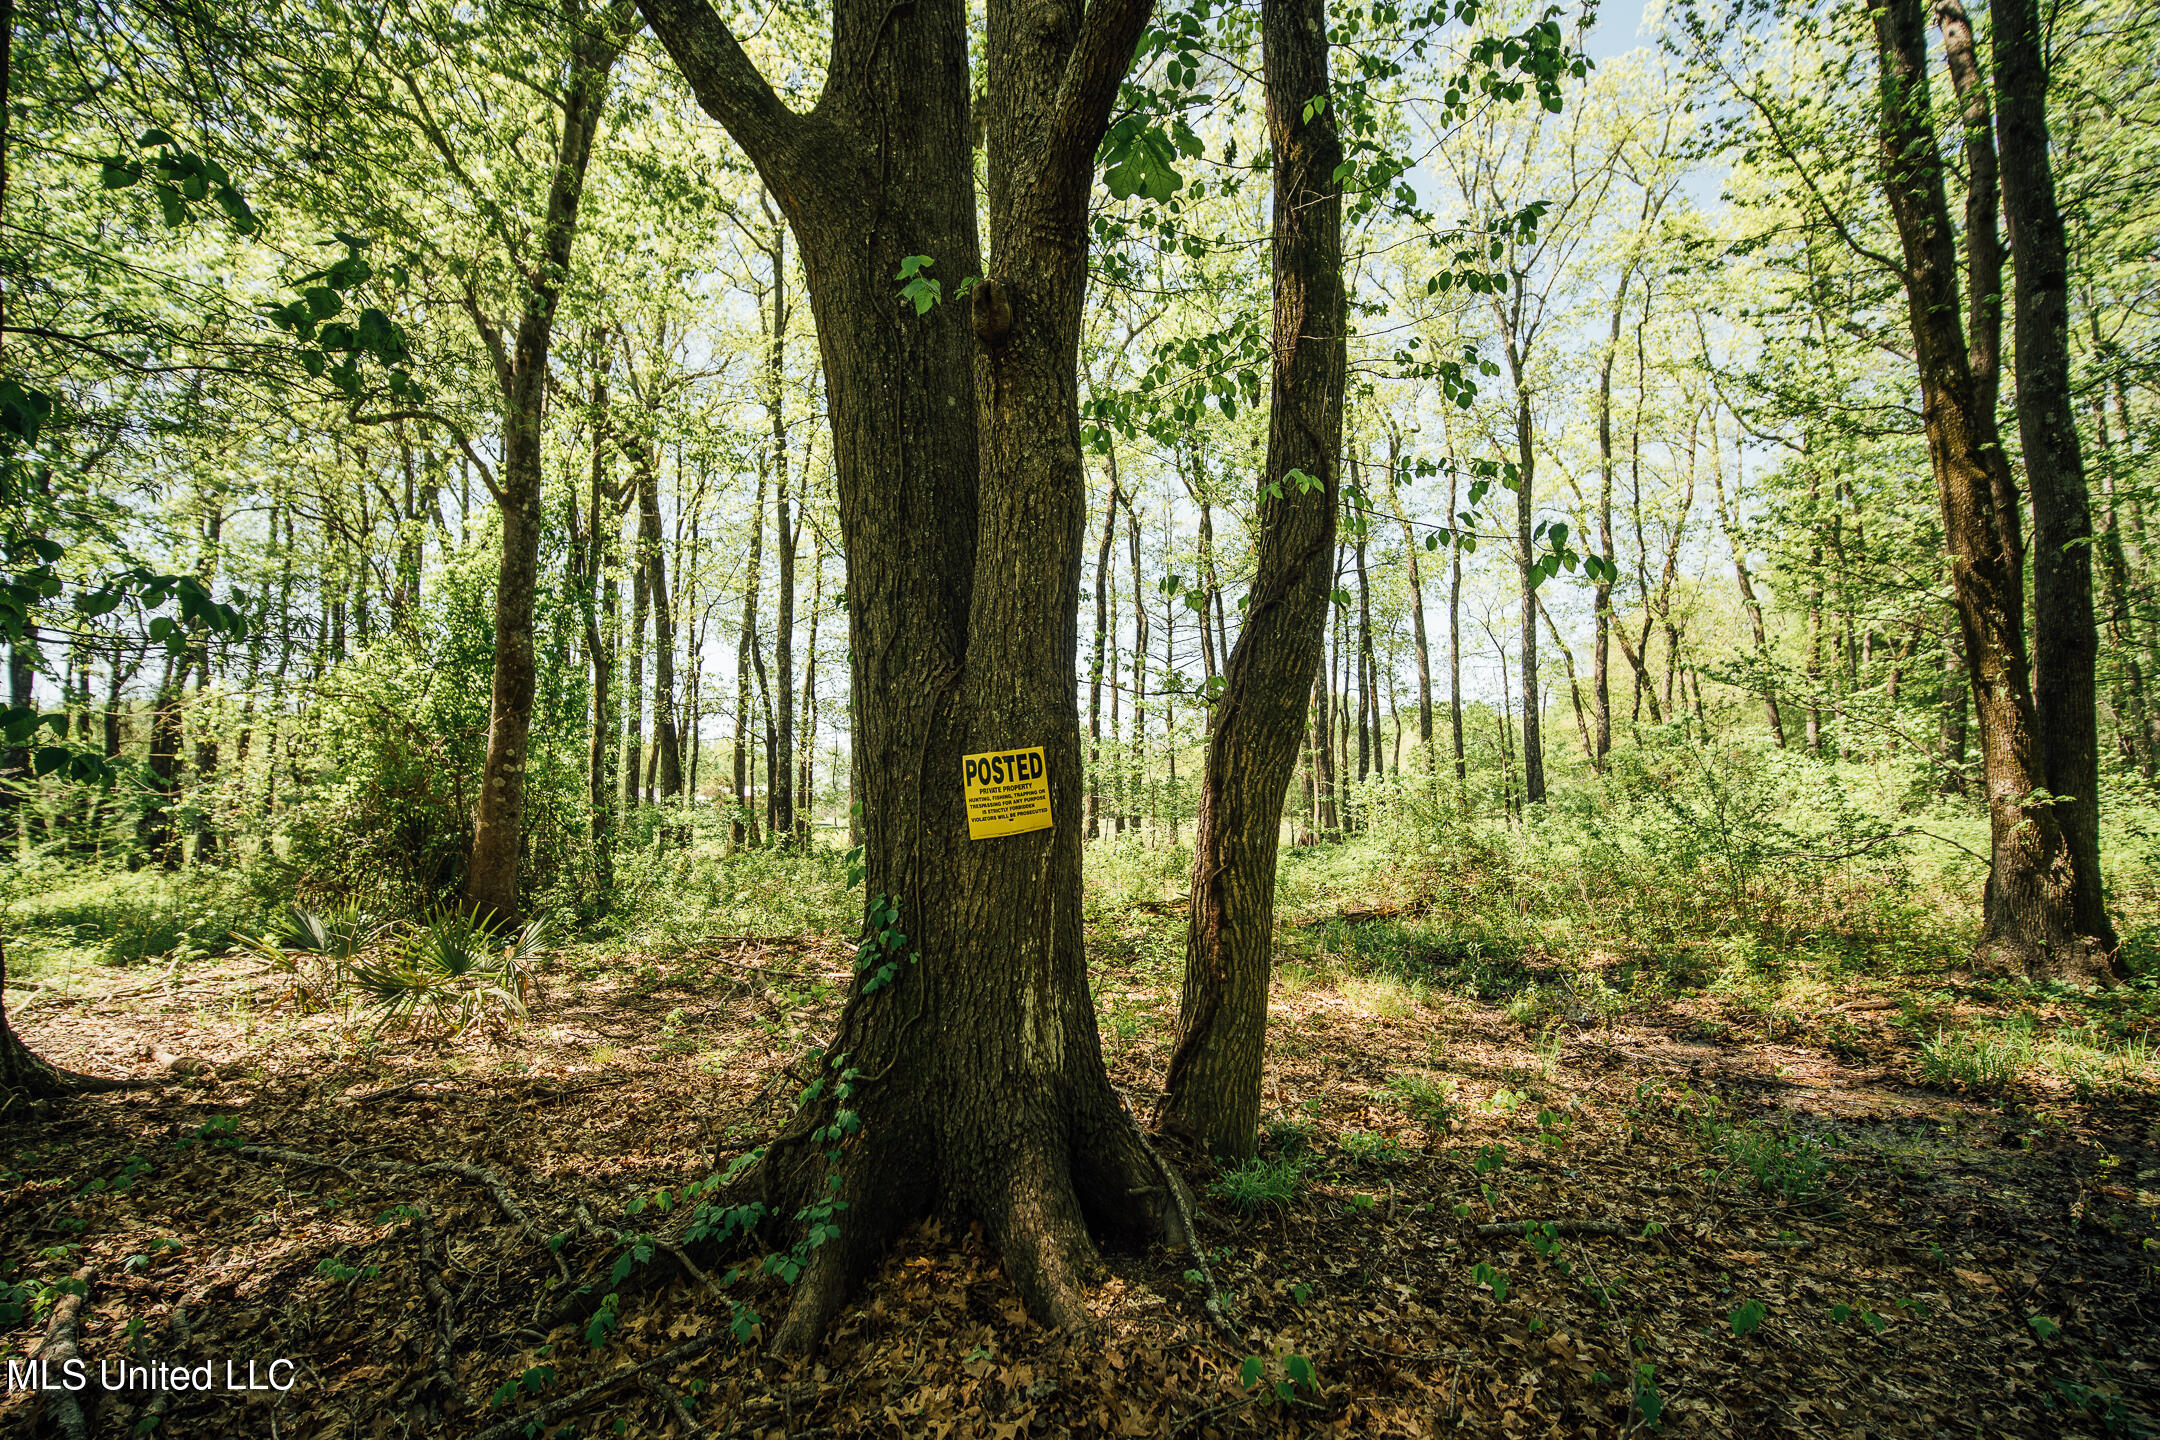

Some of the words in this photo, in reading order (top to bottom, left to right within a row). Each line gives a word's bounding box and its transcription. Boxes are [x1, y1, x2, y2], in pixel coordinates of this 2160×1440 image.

[966, 752, 1043, 786] POSTED
[1003, 783, 1032, 792] PROPERTY
[1017, 808, 1048, 816] PROSECUTED
